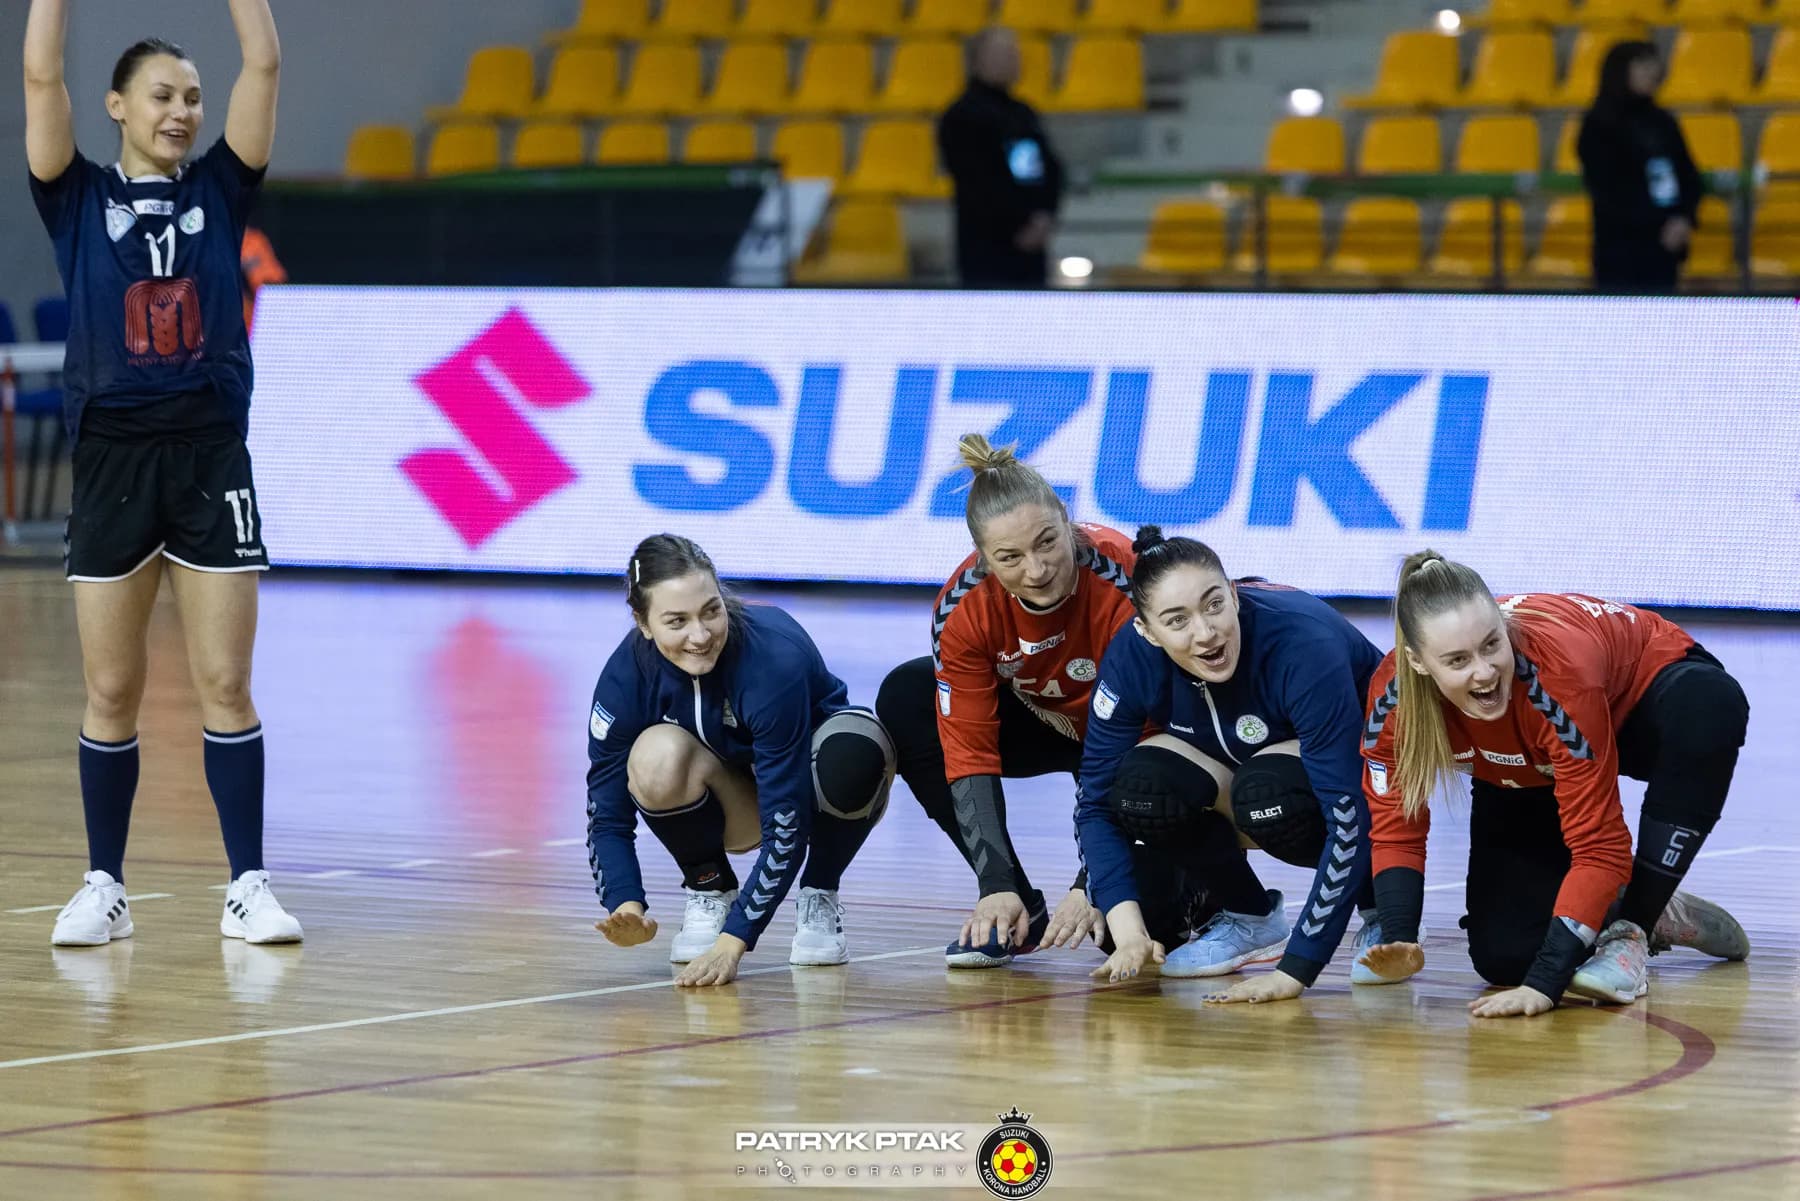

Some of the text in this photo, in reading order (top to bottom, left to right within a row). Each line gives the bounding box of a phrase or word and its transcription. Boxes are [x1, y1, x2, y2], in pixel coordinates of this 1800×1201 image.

[631, 359, 1491, 532] SUZUKI
[1487, 753, 1524, 765] PGNiG
[1250, 805, 1283, 820] SELECT
